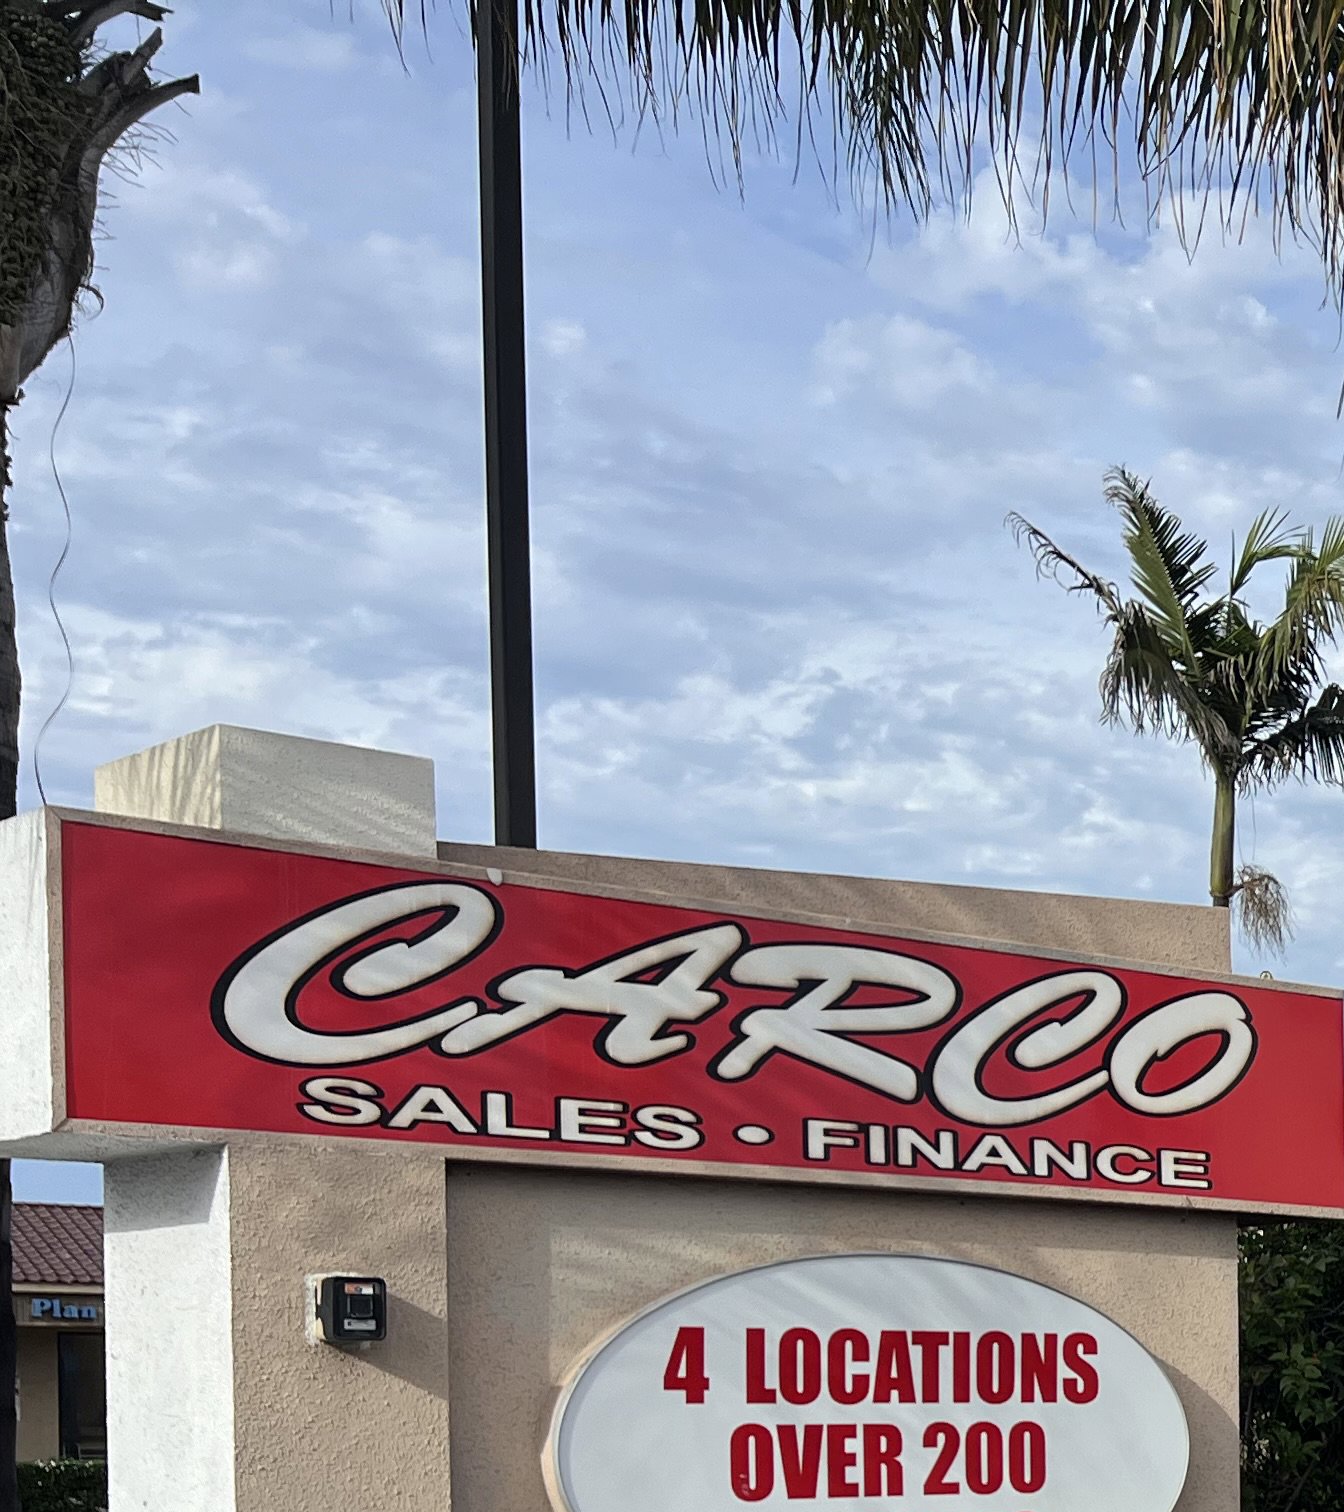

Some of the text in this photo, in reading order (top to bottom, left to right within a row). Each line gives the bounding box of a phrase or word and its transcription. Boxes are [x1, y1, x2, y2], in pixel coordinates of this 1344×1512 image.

[210, 878, 1257, 1127] CARCO
[297, 1075, 1213, 1191] SALES FINANCE
[663, 1326, 1100, 1405] 4 LOCATIONS
[729, 1420, 1047, 1502] OVER 200
